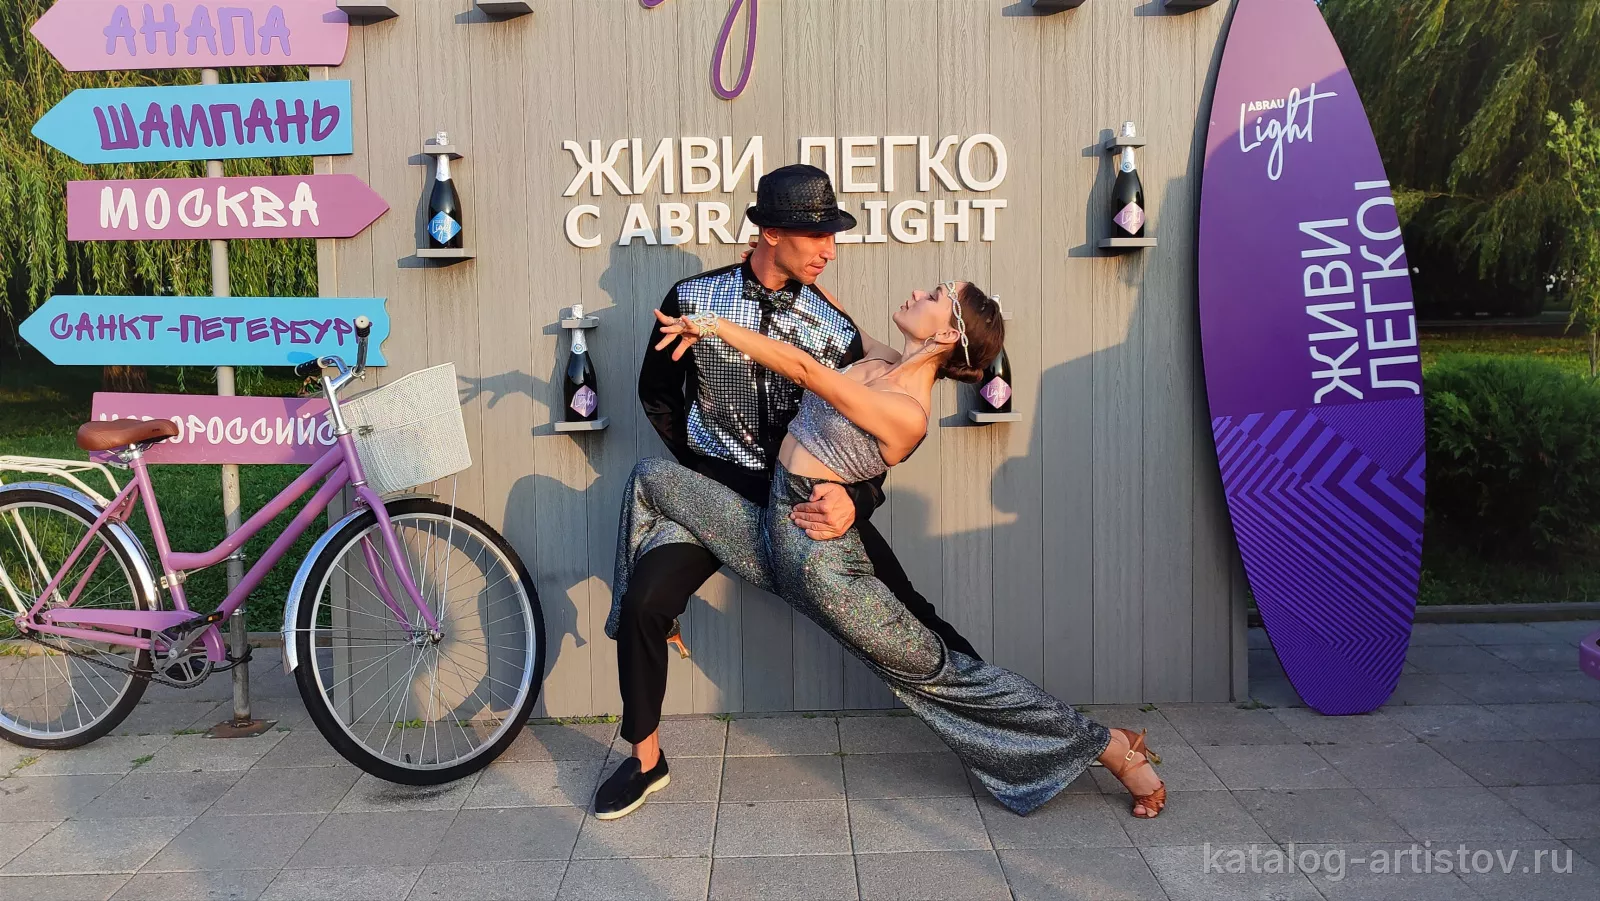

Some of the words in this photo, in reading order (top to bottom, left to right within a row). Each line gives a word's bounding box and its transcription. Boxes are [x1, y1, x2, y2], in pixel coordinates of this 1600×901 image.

[103, 3, 292, 57] АНАПА
[93, 98, 340, 150] ШАМПАНЬ
[1239, 82, 1338, 181] Light
[1248, 98, 1285, 112] ABRAU
[563, 135, 764, 197] ЖИВИ
[99, 182, 320, 230] МОСКВА
[618, 202, 760, 246] ABR
[1298, 217, 1364, 404] ЖИВИ
